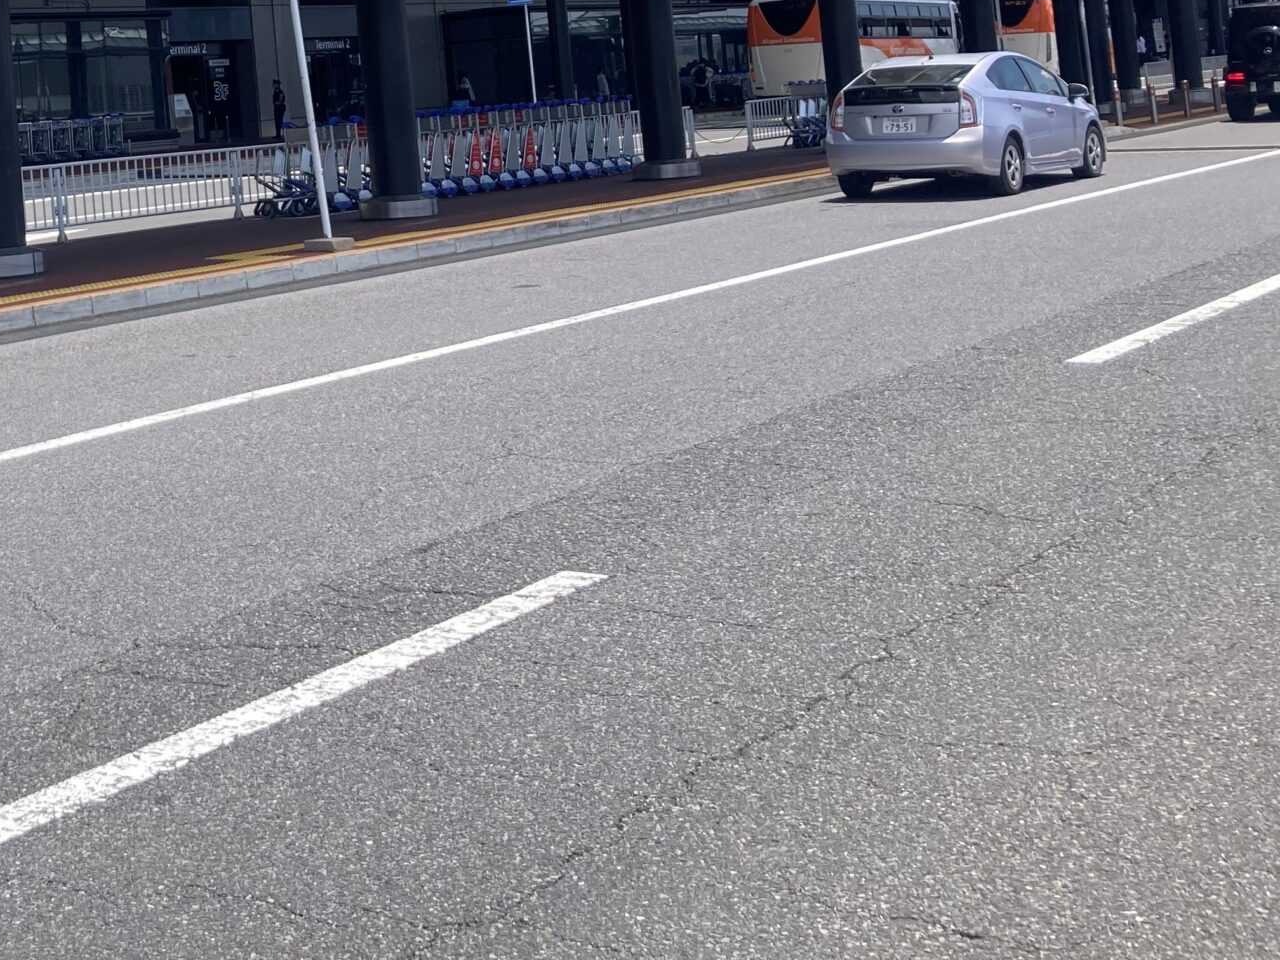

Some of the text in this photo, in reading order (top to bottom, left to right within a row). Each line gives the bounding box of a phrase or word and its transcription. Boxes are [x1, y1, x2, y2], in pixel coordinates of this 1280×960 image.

[170, 43, 207, 55] erminal 2
[314, 38, 351, 49] Terminal 2
[213, 80, 229, 101] 3F
